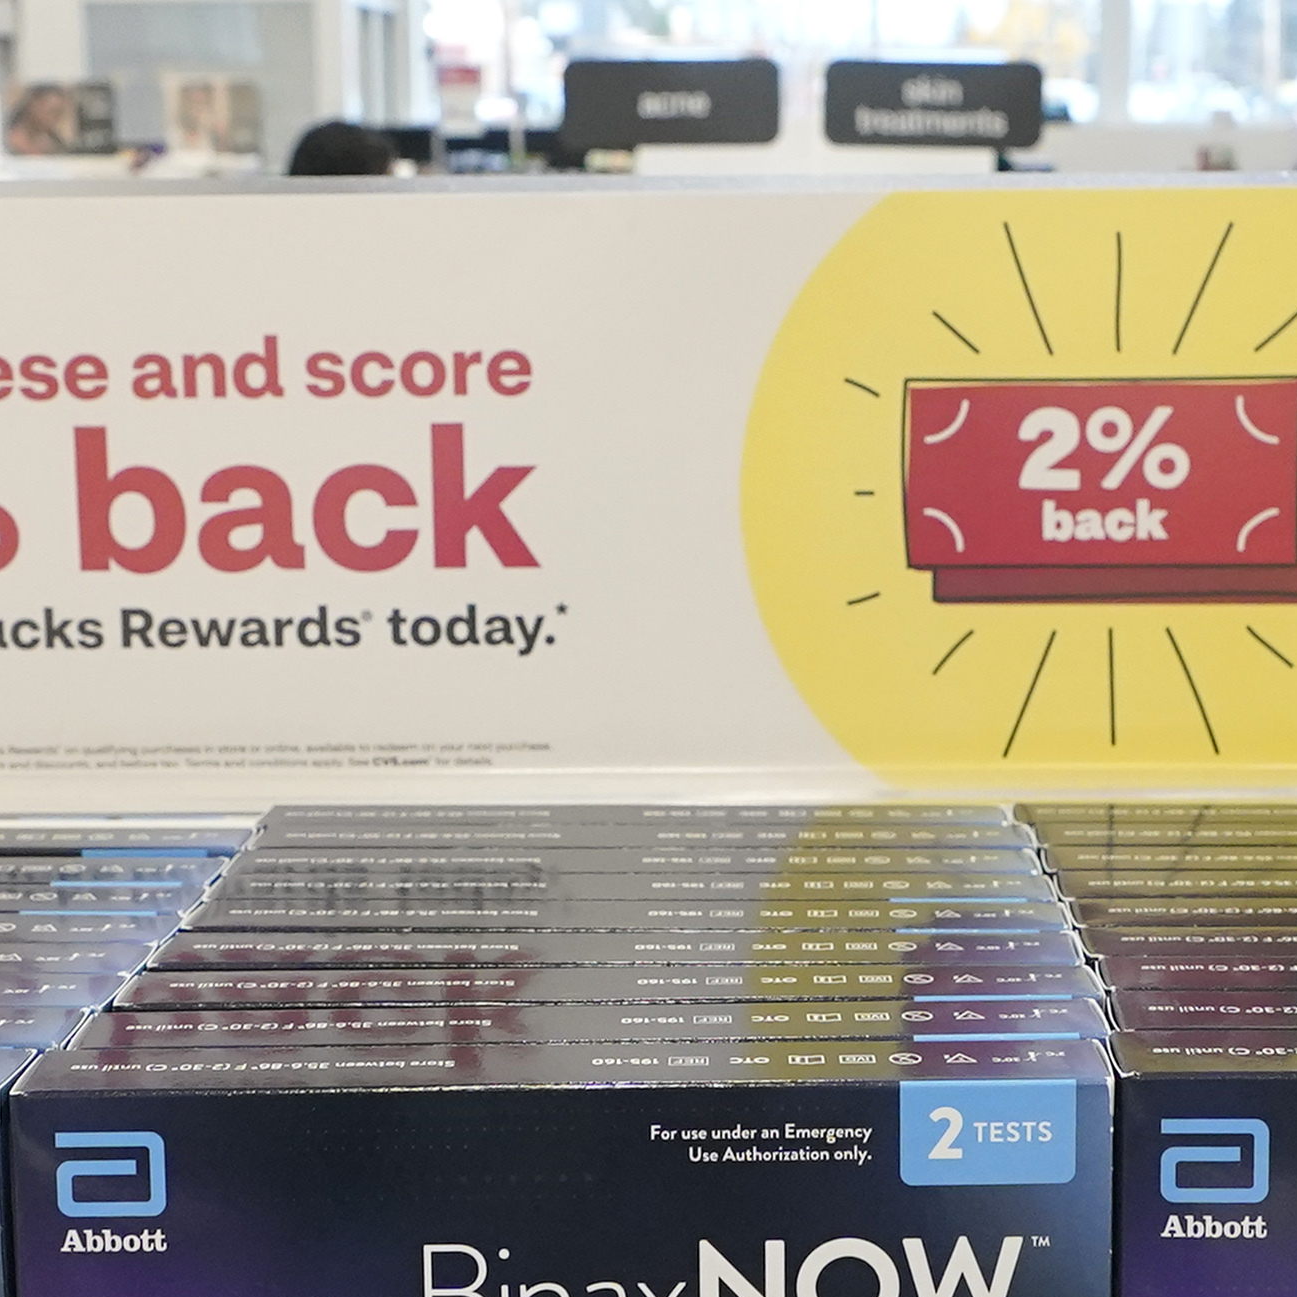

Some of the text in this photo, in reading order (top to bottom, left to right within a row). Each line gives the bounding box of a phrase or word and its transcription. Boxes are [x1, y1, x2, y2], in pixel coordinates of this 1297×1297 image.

[855, 105, 1009, 137] treatments
[132, 336, 283, 399] and
[305, 347, 532, 397] score
[1017, 406, 1190, 492] 2%
[74, 422, 541, 573] back
[1041, 498, 1169, 543] back
[650, 1124, 873, 1146] For use under an Emergency
[928, 1107, 1052, 1161] 2 TESTS
[688, 1146, 872, 1164] Use Authorization only.
[61, 1229, 167, 1252] Abbott
[1161, 1215, 1267, 1239] Abbott
